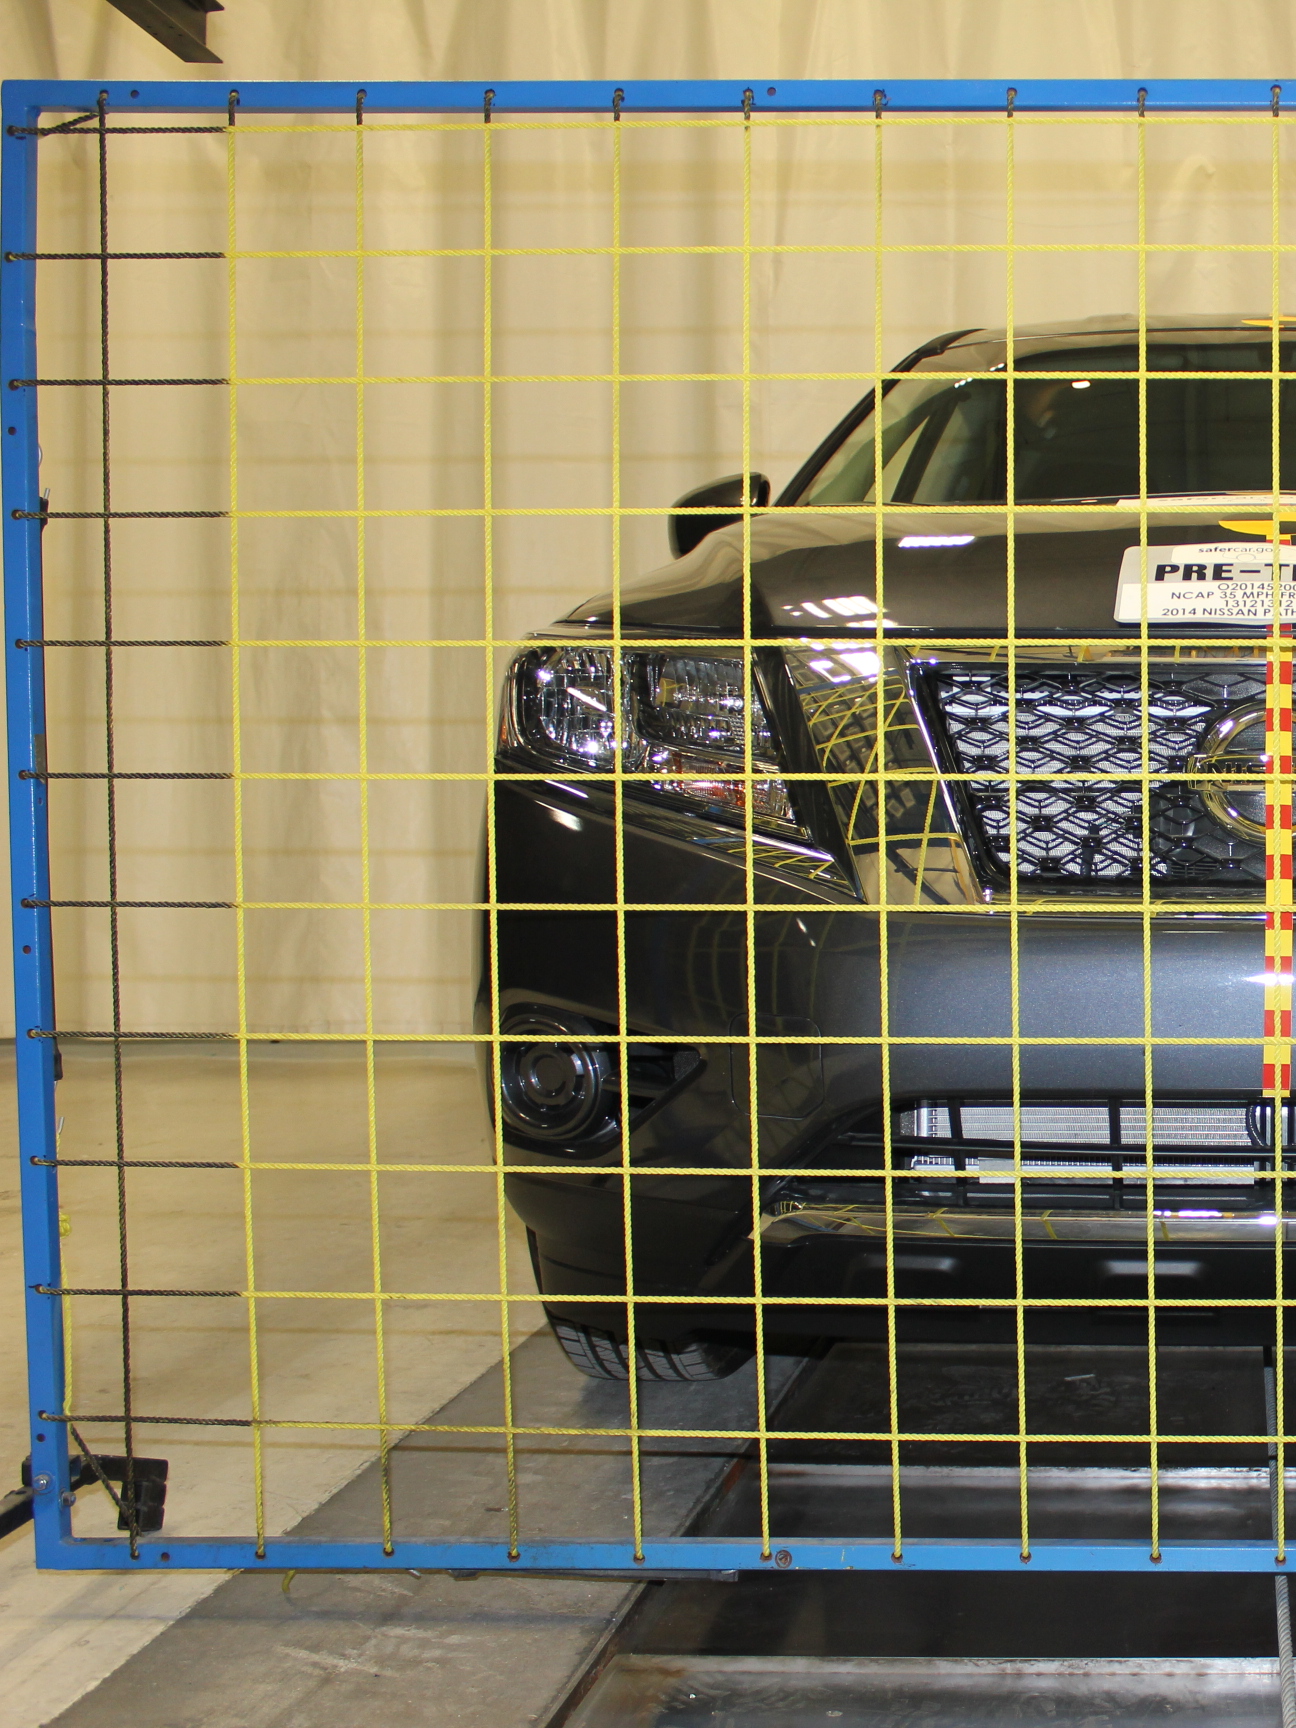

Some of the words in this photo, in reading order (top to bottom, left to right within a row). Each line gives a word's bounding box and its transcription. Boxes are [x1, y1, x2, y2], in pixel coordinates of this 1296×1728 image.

[1171, 591, 1214, 599] NCAP
[1220, 591, 1237, 599] 35
[1242, 591, 1274, 599] MPH
[1225, 600, 1293, 608] 13121312
[1161, 608, 1196, 616] 2014
[1202, 608, 1257, 616] NISSAN
